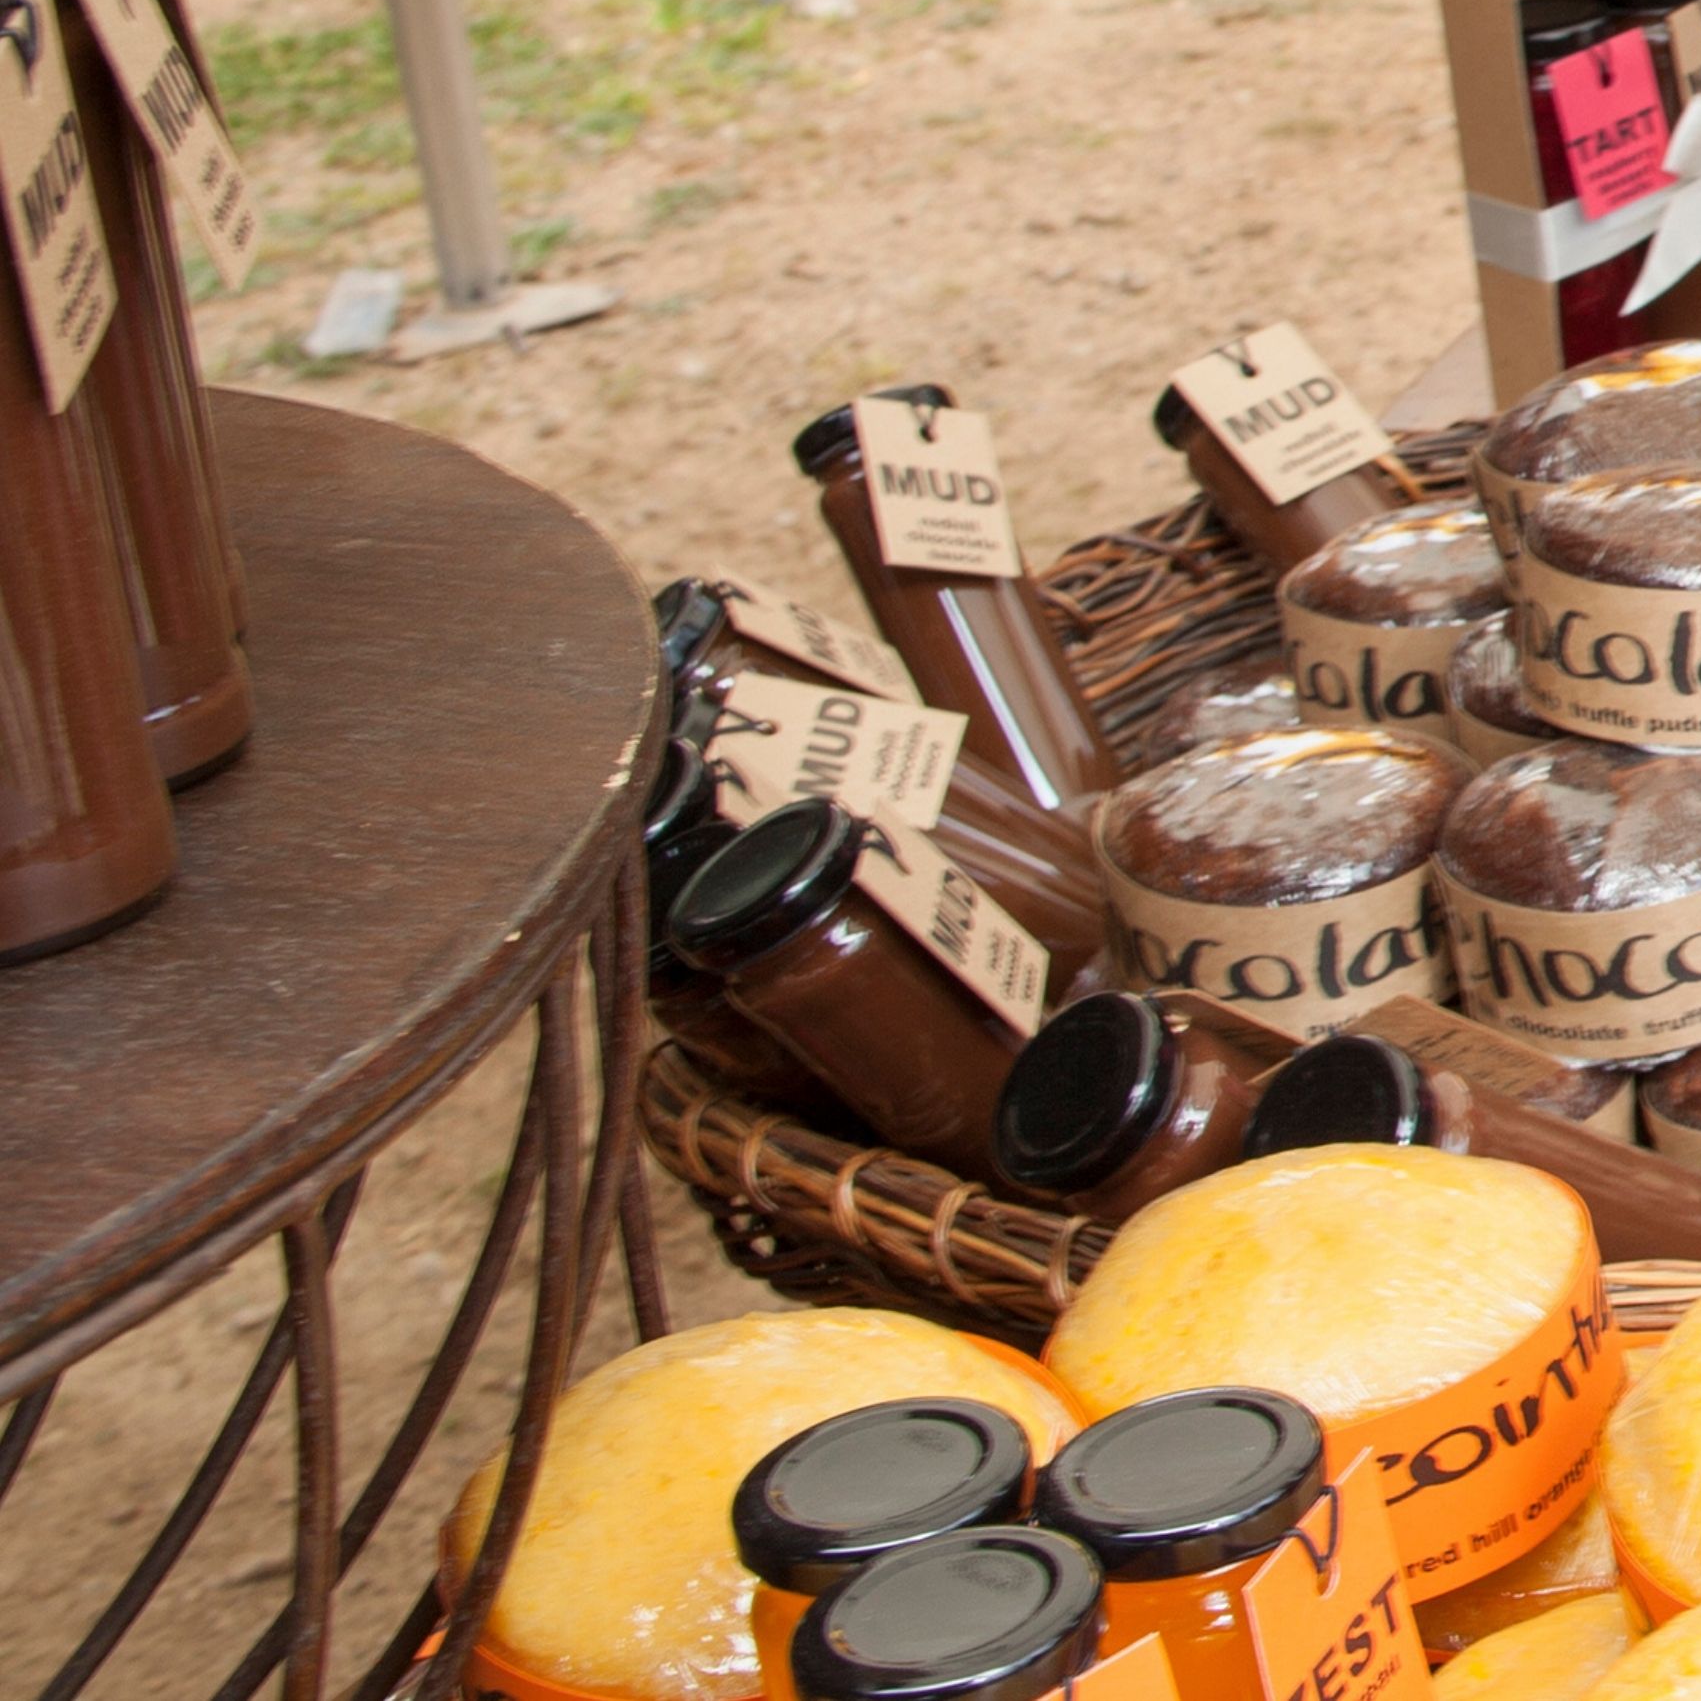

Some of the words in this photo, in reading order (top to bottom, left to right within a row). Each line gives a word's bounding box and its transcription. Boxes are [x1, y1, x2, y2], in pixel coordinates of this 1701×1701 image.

[1568, 108, 1658, 164] TART
[1225, 376, 1338, 445] MUD
[880, 461, 998, 507] MUD
[791, 696, 864, 797] MUD
[1405, 1542, 1461, 1580] red
[1470, 1511, 1520, 1554] hill
